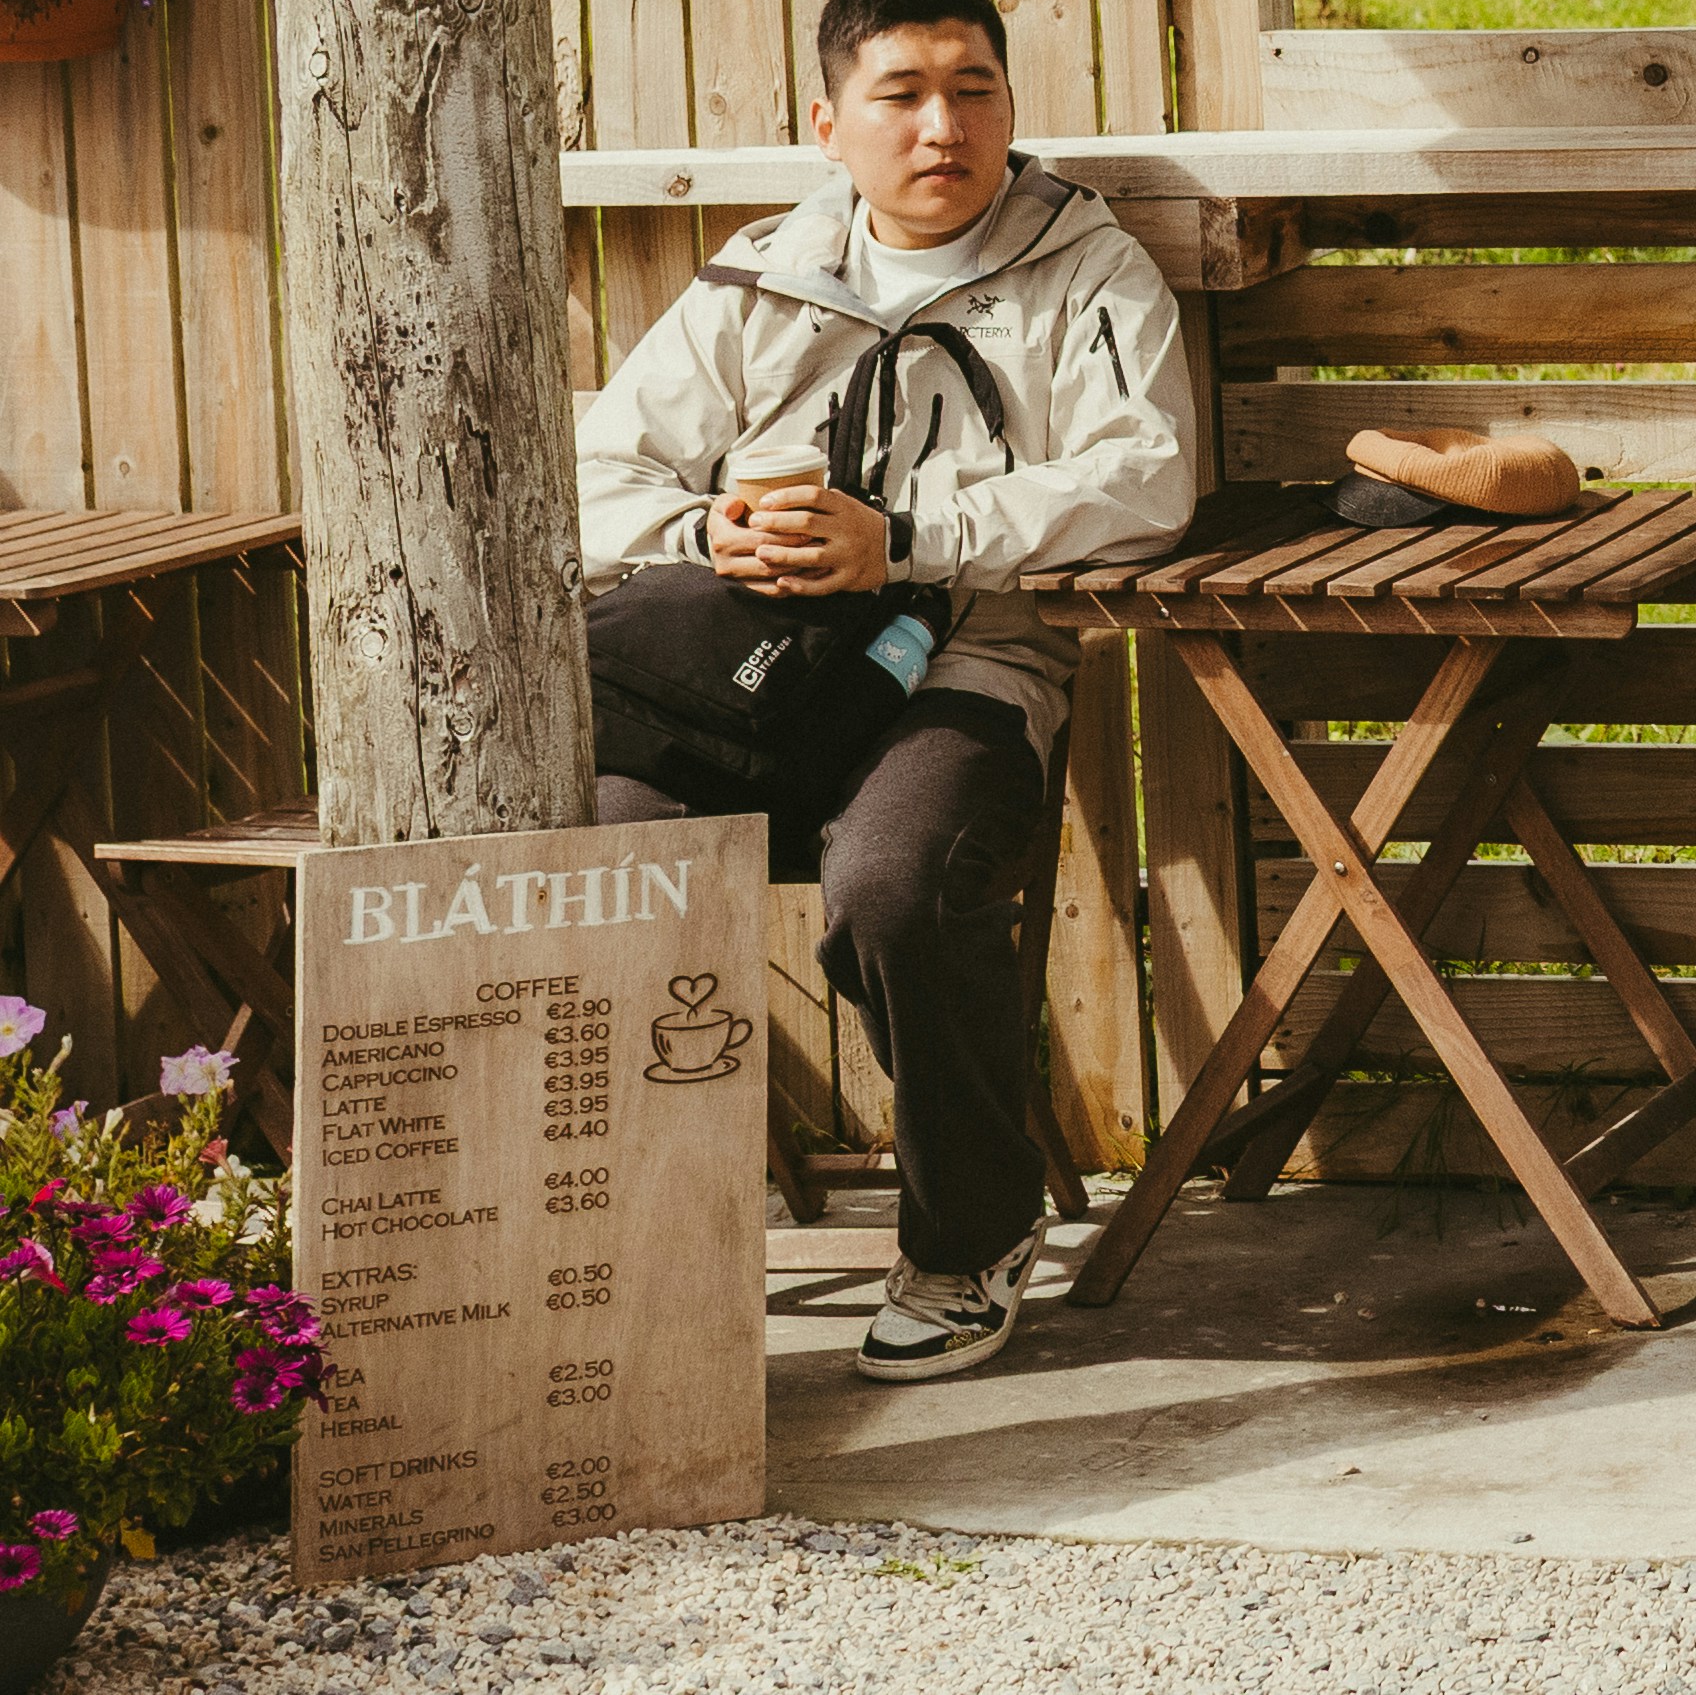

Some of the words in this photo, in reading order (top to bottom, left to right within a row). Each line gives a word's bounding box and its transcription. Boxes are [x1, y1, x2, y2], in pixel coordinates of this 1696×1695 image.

[748, 640, 773, 665] CPC
[759, 649, 781, 671] TEAM
[343, 851, 693, 945] BLÁTHÍN
[476, 975, 580, 1003] COFFEE
[322, 1019, 409, 1043] DOUBLE
[414, 1009, 522, 1034] ESPRESSO
[546, 997, 612, 1020] €2.90
[321, 1041, 445, 1068] AMERICANO
[544, 1022, 610, 1044] €3.60
[322, 1064, 459, 1092] CAPPUCCINO
[544, 1045, 610, 1069] €3.95
[322, 1096, 387, 1117] LATTE
[544, 1070, 610, 1093] €3.95
[322, 1122, 375, 1142] FLAT
[378, 1114, 446, 1135] WHITE
[544, 1094, 609, 1117] €3.95
[322, 1148, 370, 1167] ICED
[375, 1137, 460, 1161] COFFEE
[543, 1119, 609, 1142] €4.40
[321, 1197, 372, 1216] CHAI
[377, 1188, 441, 1209] LATTE
[544, 1167, 610, 1191] €4.00
[322, 1222, 367, 1241] HOT
[371, 1206, 499, 1236] CHOCOLATE
[544, 1191, 610, 1215] €3.60
[320, 1293, 389, 1316] SYRUP
[547, 1262, 613, 1287] €0.50
[321, 1263, 418, 1290] EXTRAS:
[320, 1308, 456, 1341] ALTERNATIVE
[462, 1301, 511, 1323] MILK
[545, 1287, 611, 1311] €0.50
[548, 1358, 614, 1383] €2.50
[320, 1415, 403, 1439] HERBAL
[545, 1382, 612, 1407] €3.00
[318, 1490, 392, 1513] WATER
[545, 1455, 611, 1479] €2.00
[319, 1462, 386, 1488] SOFT
[390, 1449, 478, 1478] DRINKS
[319, 1510, 424, 1539] MINERALS
[541, 1480, 606, 1505] €2.50
[319, 1544, 364, 1564] SAN
[368, 1523, 495, 1552] PELLEGRINO
[551, 1503, 617, 1528] €3.00
